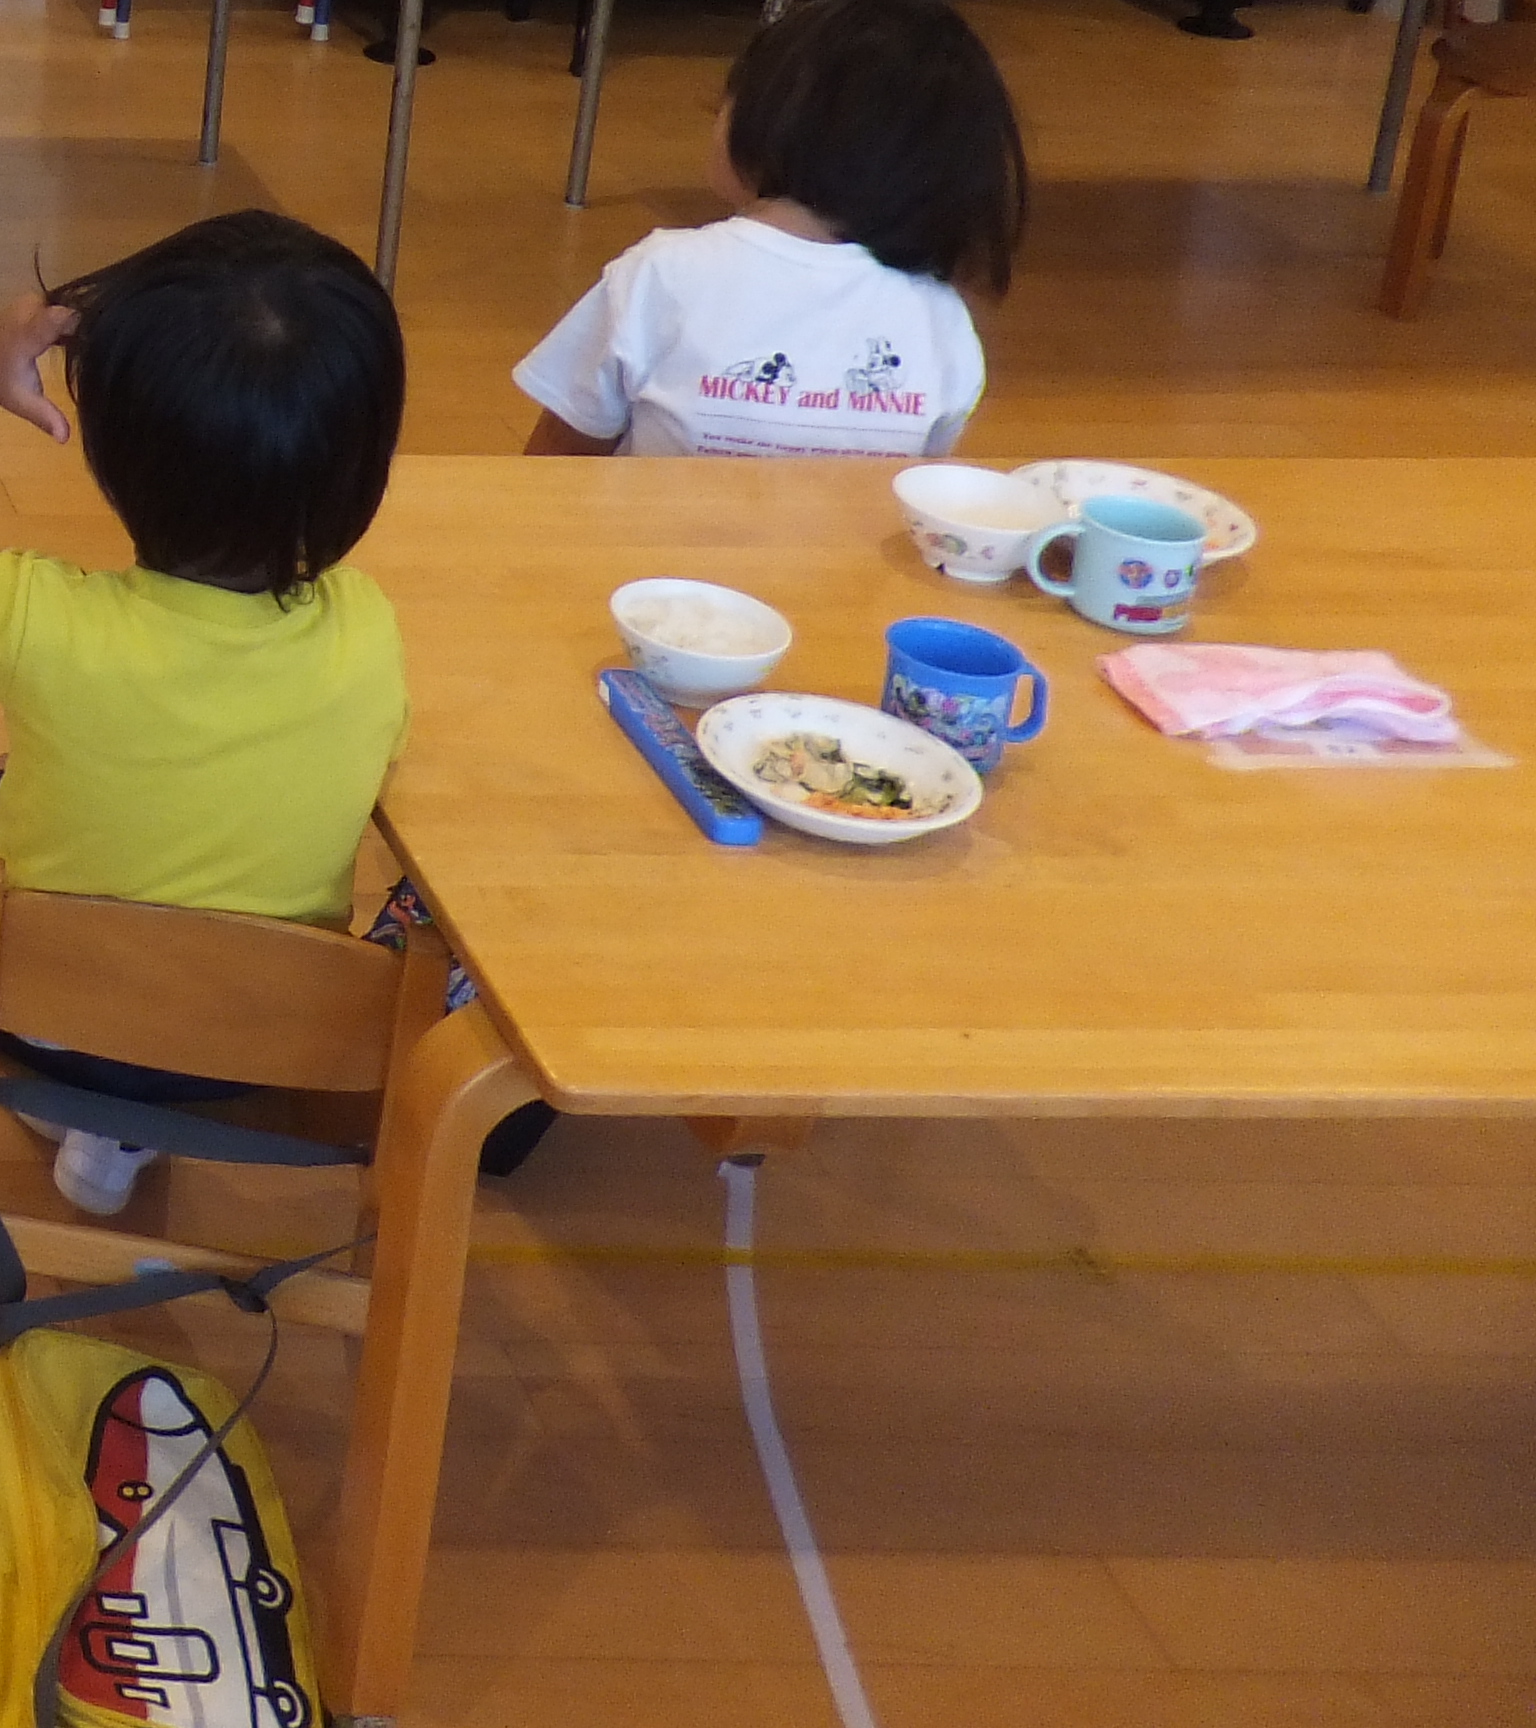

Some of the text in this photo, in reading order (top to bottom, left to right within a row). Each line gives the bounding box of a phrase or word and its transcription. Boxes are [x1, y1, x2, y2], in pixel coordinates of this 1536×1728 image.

[698, 375, 927, 415] MICKEY and MINNIE
